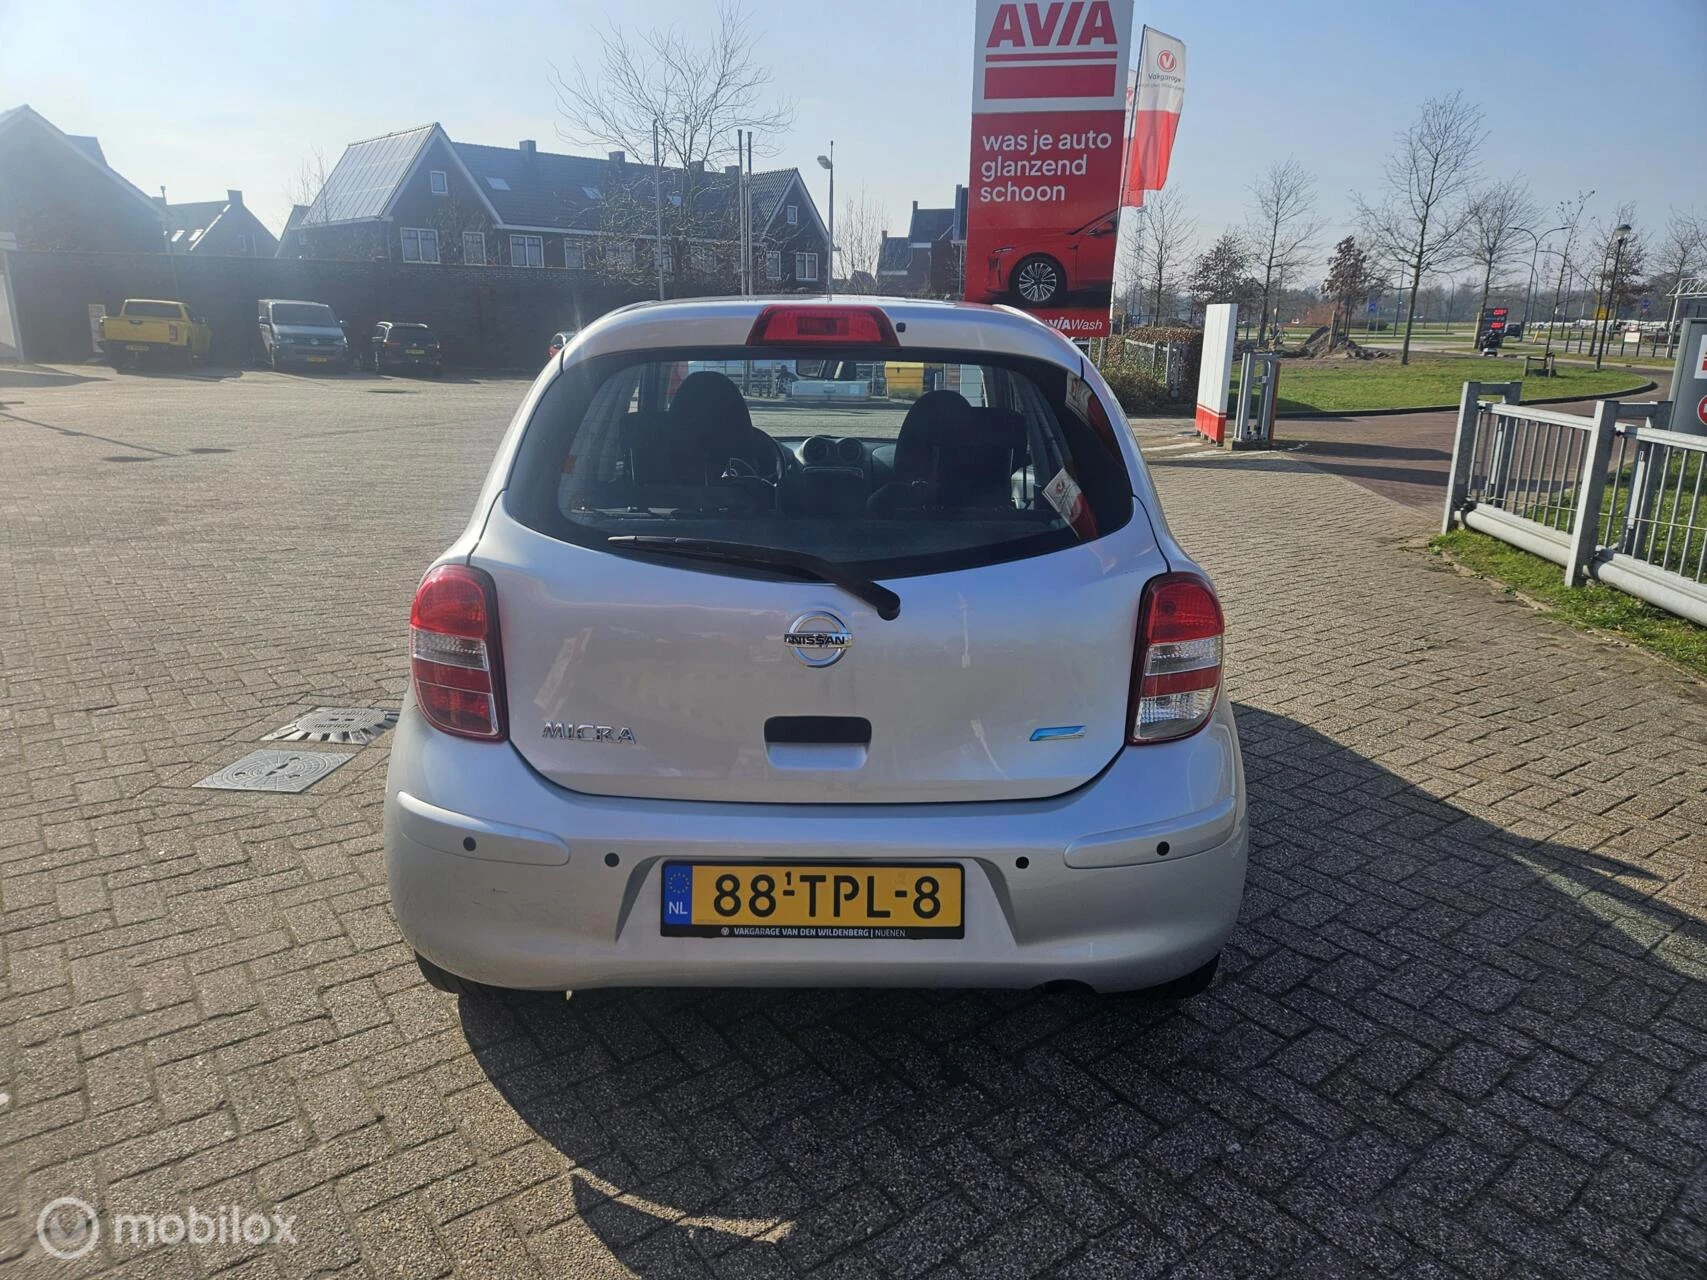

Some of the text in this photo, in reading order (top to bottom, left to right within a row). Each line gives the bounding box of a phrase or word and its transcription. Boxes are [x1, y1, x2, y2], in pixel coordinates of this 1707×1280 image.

[986, 1, 1118, 48] AVIA
[982, 129, 1112, 156] was je auto
[981, 153, 1087, 182] glanzend
[980, 181, 1066, 202] schoon
[792, 635, 845, 645] NISSAN
[542, 721, 637, 745] MICRA
[668, 901, 688, 915] NL
[734, 927, 906, 937] VAKGARAGE VAN DEN WILDENBERG NUENEN
